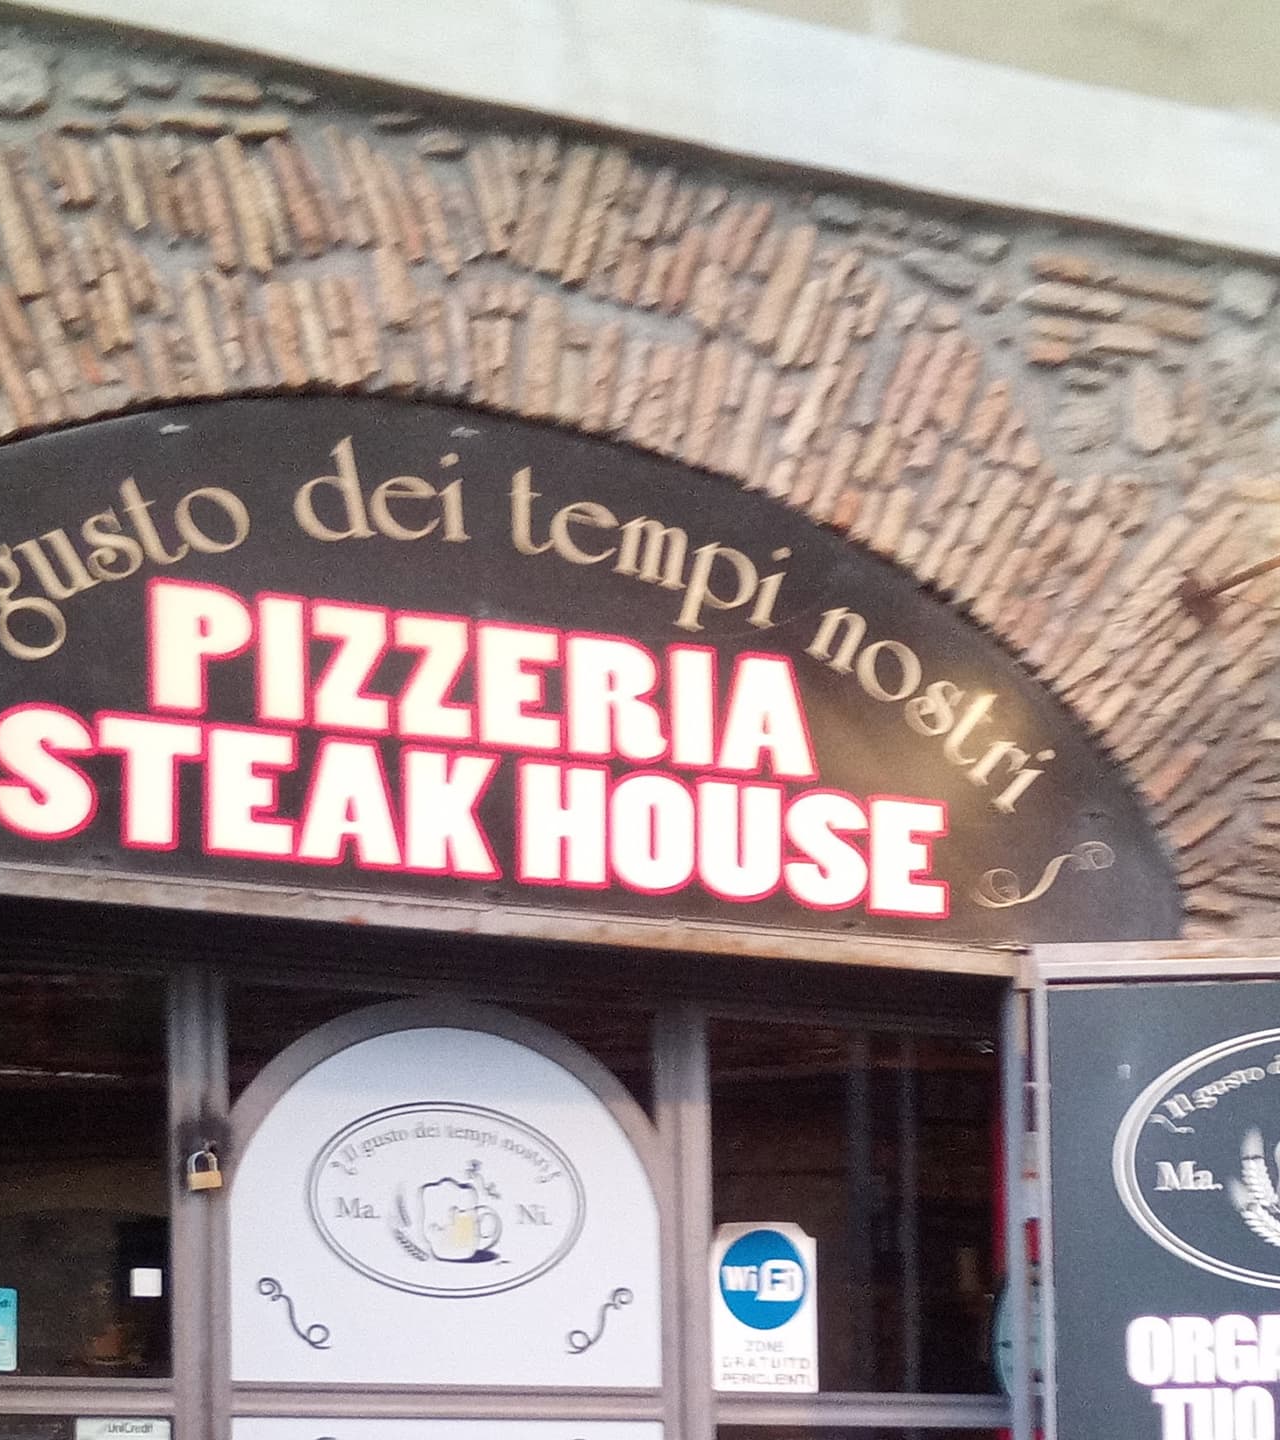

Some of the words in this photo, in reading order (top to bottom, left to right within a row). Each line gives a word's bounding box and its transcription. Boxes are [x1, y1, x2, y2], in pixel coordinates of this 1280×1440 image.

[295, 435, 470, 545] dei
[509, 465, 791, 632] tempi
[801, 599, 1060, 814] nostri
[145, 577, 818, 780] PIZZERIA
[515, 758, 949, 918] HOUSE
[1192, 1067, 1265, 1108] gusto
[362, 1128, 408, 1157] gusto
[415, 1121, 440, 1139] dei
[447, 1124, 497, 1145] tempi
[501, 1138, 550, 1174] nostri
[1154, 1160, 1223, 1191] Ma.
